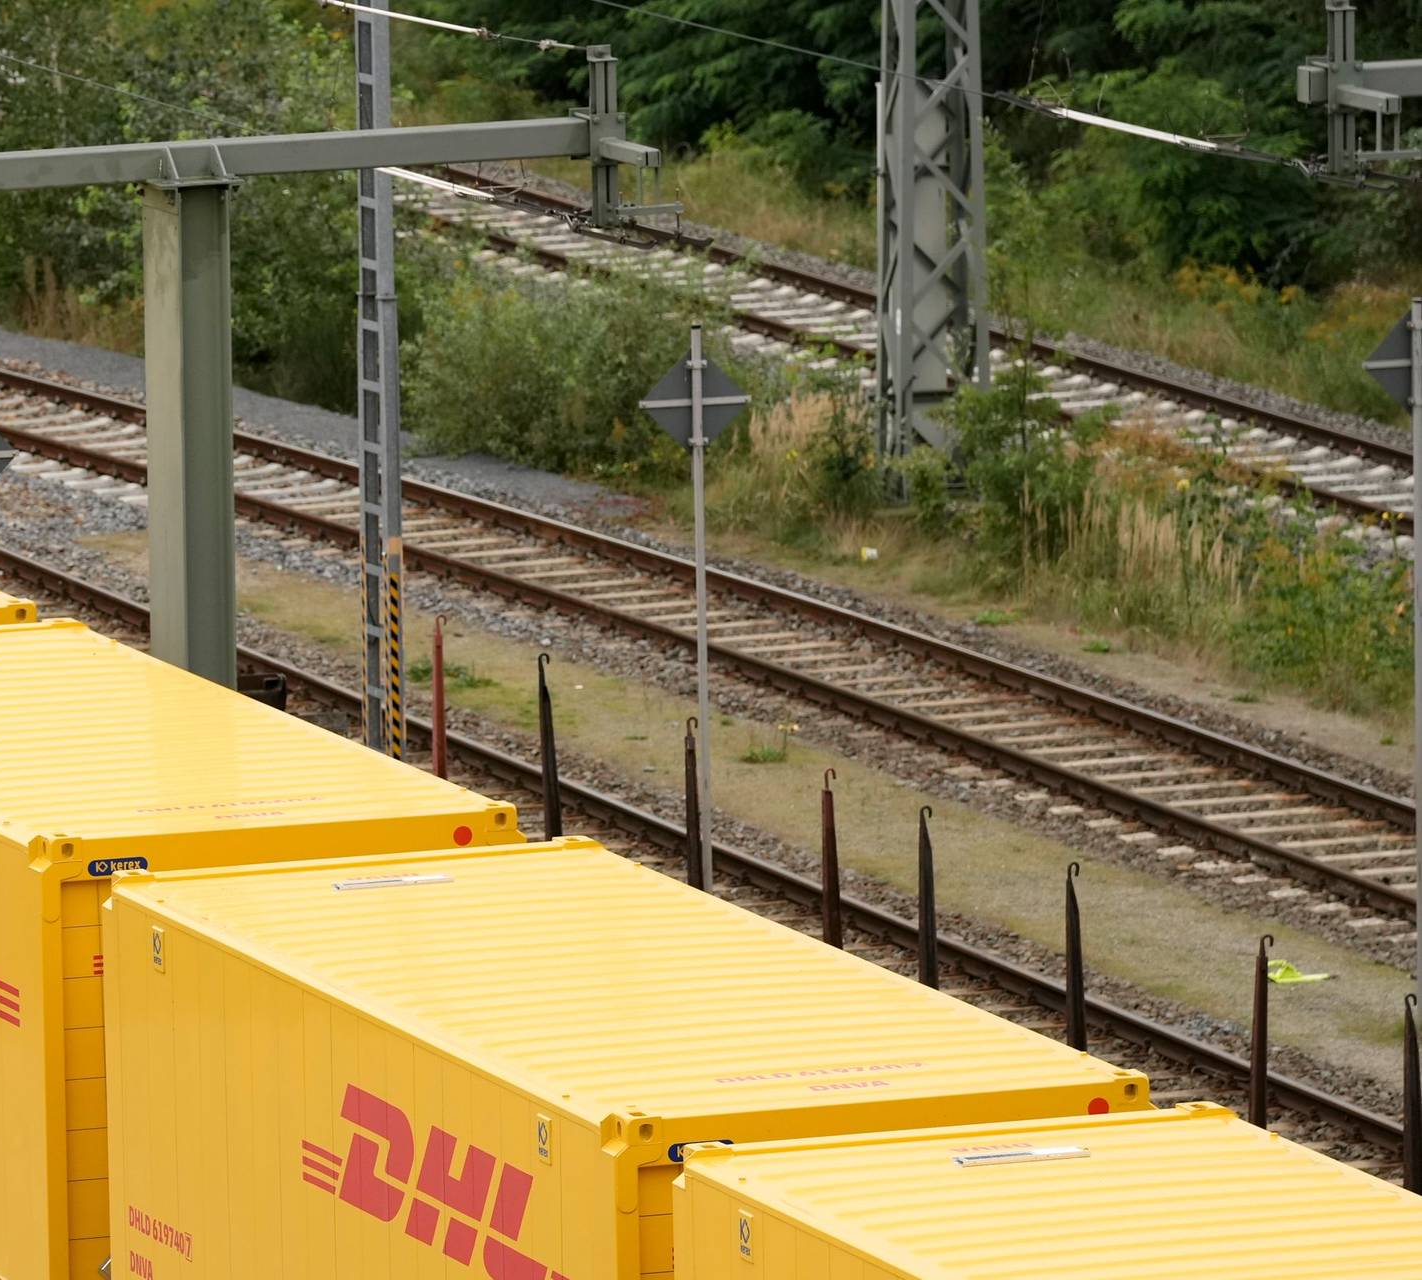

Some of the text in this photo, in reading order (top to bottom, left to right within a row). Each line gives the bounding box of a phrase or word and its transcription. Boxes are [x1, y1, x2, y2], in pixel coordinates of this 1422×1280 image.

[111, 860, 141, 871] kerex
[339, 1083, 548, 1280] DHL
[129, 1205, 151, 1236] DHLD
[153, 1219, 185, 1254] 619740
[130, 1250, 154, 1280] DNVA
